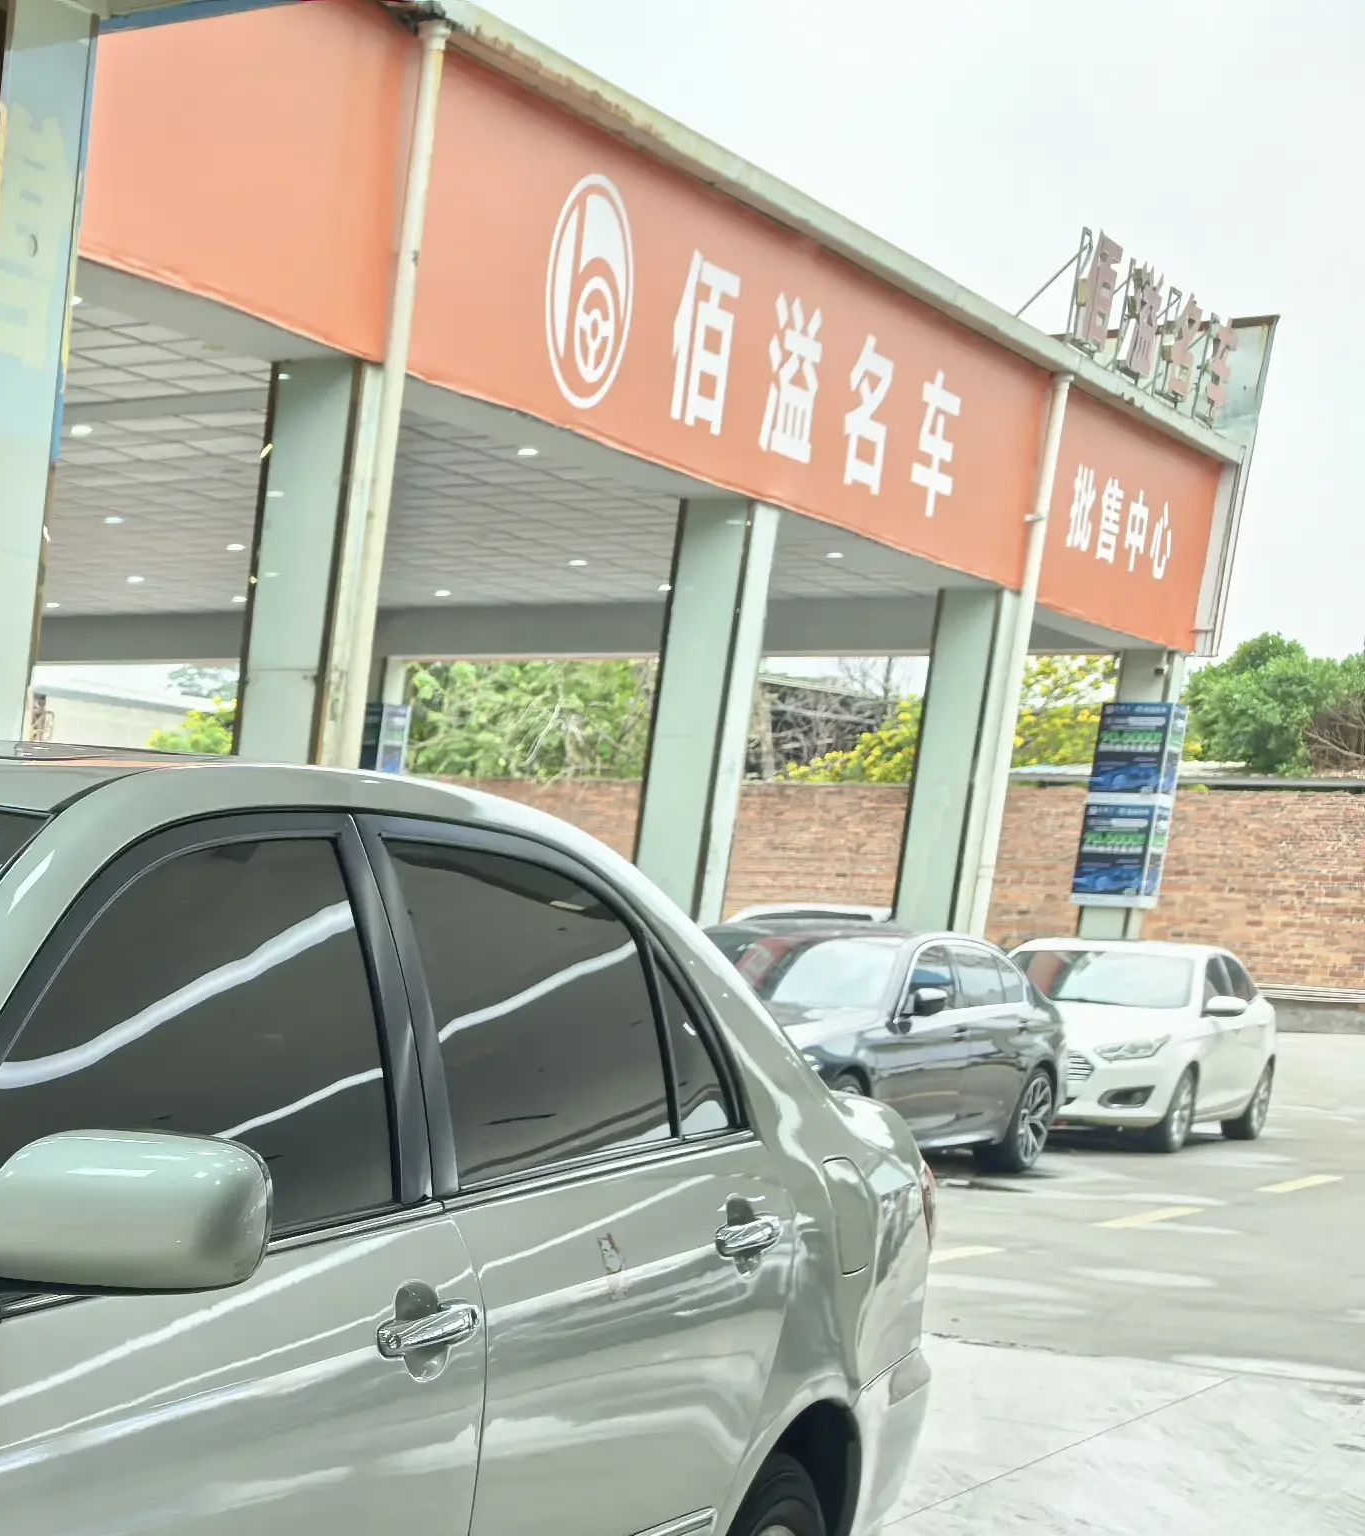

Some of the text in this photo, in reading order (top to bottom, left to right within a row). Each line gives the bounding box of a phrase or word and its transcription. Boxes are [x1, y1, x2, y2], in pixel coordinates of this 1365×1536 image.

[671, 249, 962, 517] 佰溢名车
[1064, 462, 1173, 581] 批售中心
